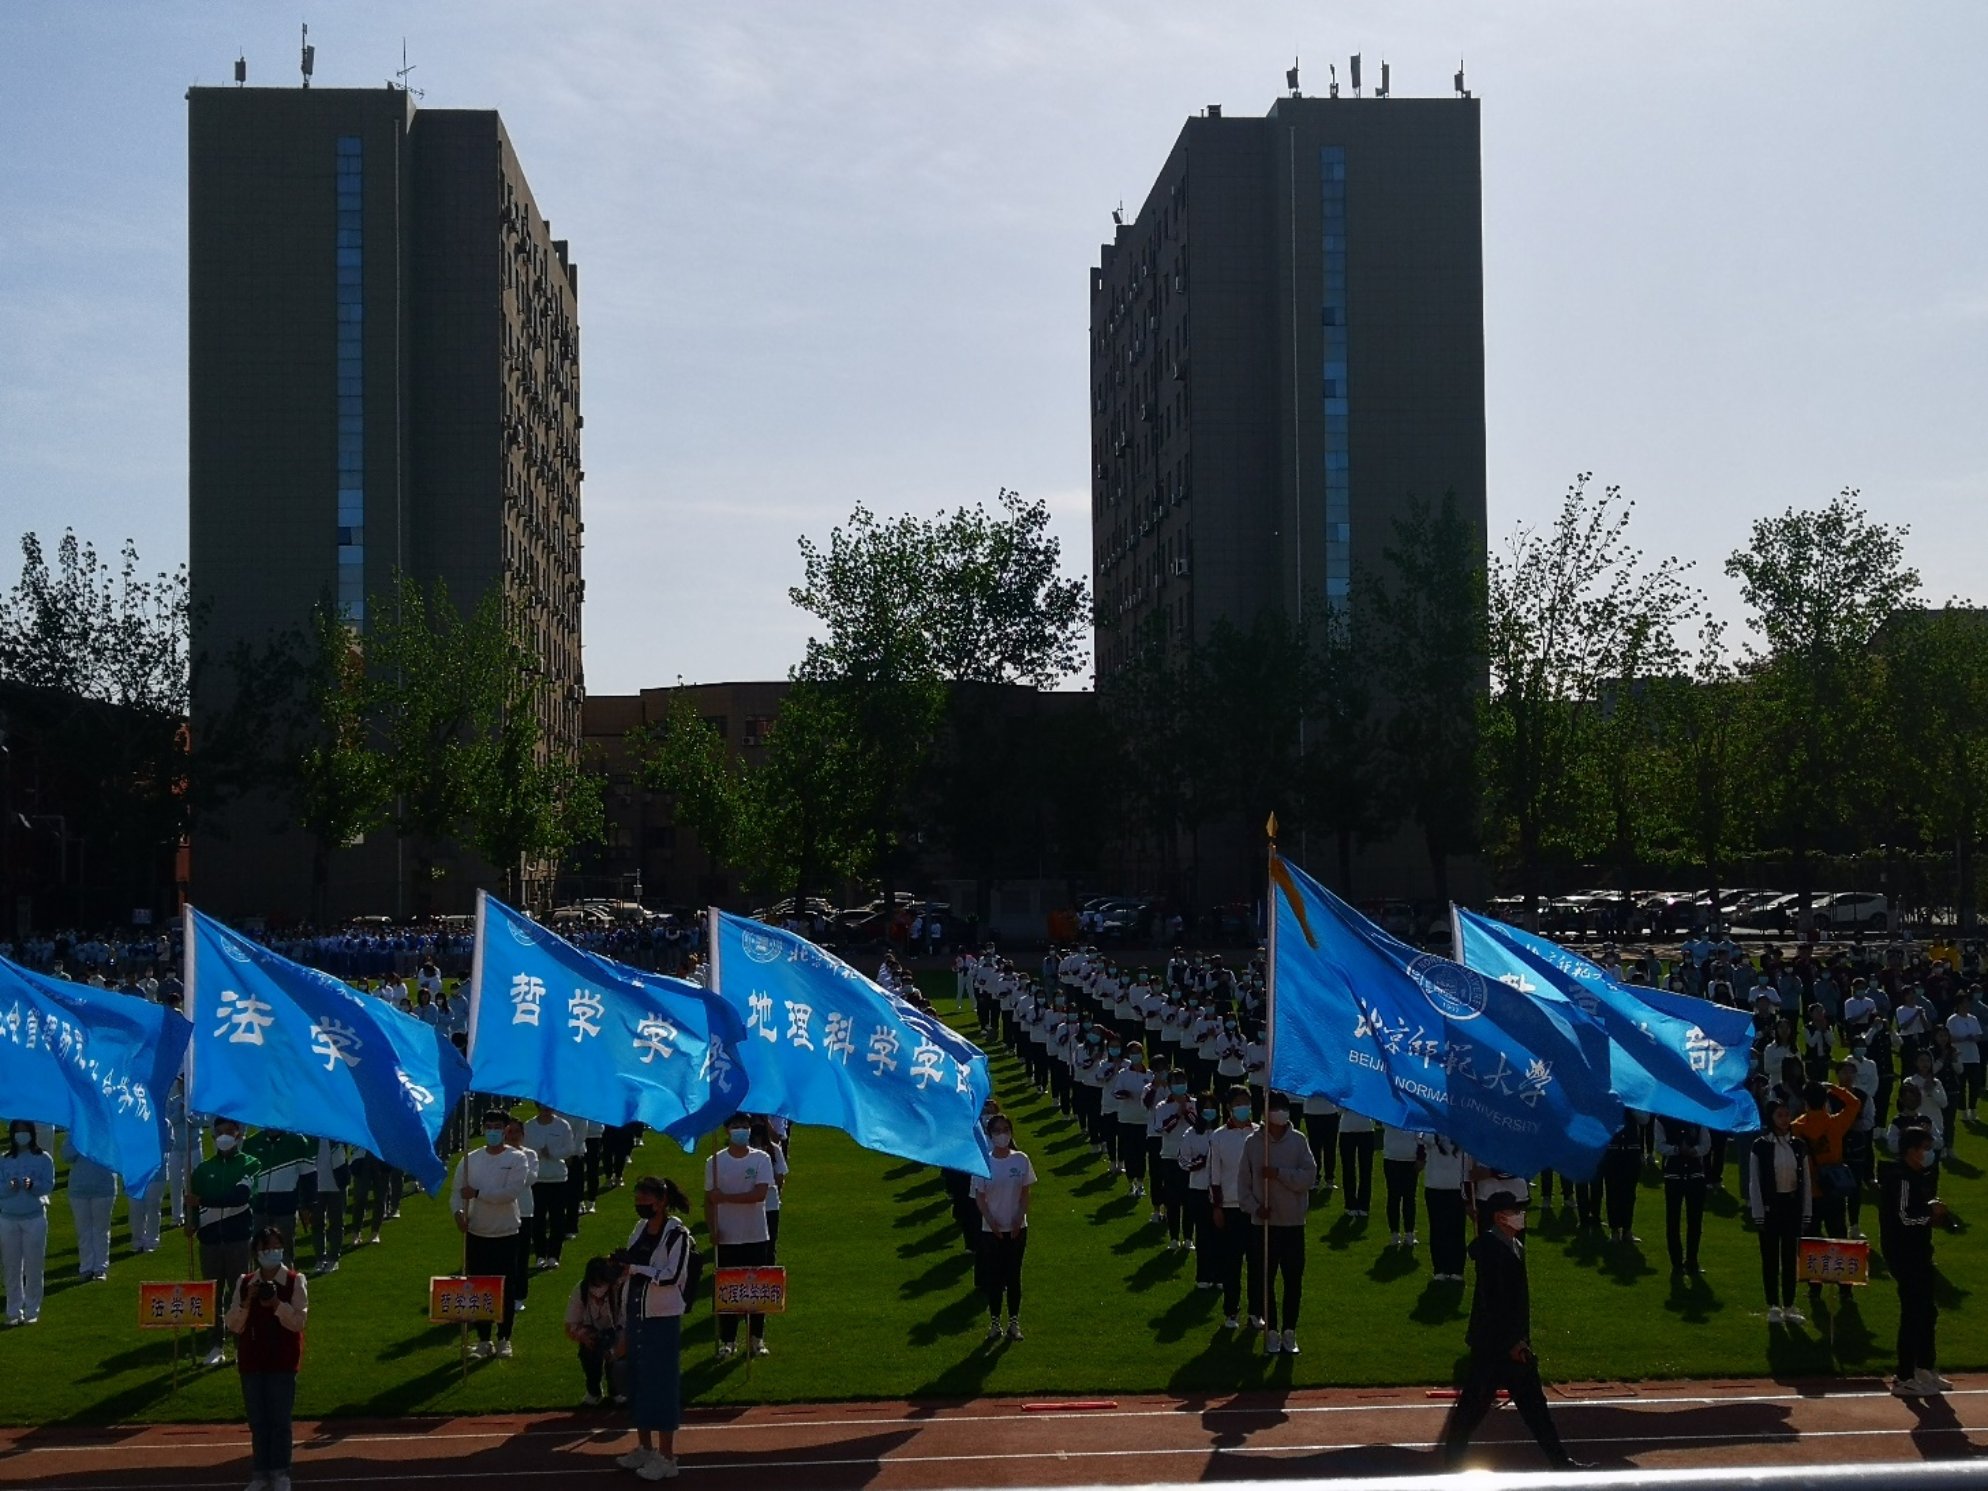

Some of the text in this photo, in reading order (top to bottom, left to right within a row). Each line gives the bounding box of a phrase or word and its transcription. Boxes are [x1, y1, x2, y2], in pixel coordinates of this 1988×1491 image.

[509, 971, 732, 1093] 哲学学院
[1348, 1050, 1544, 1134] BEIJI NORMAL UNIVERSITY
[151, 1297, 204, 1318] 法学院
[440, 1292, 493, 1314] 哲学学院
